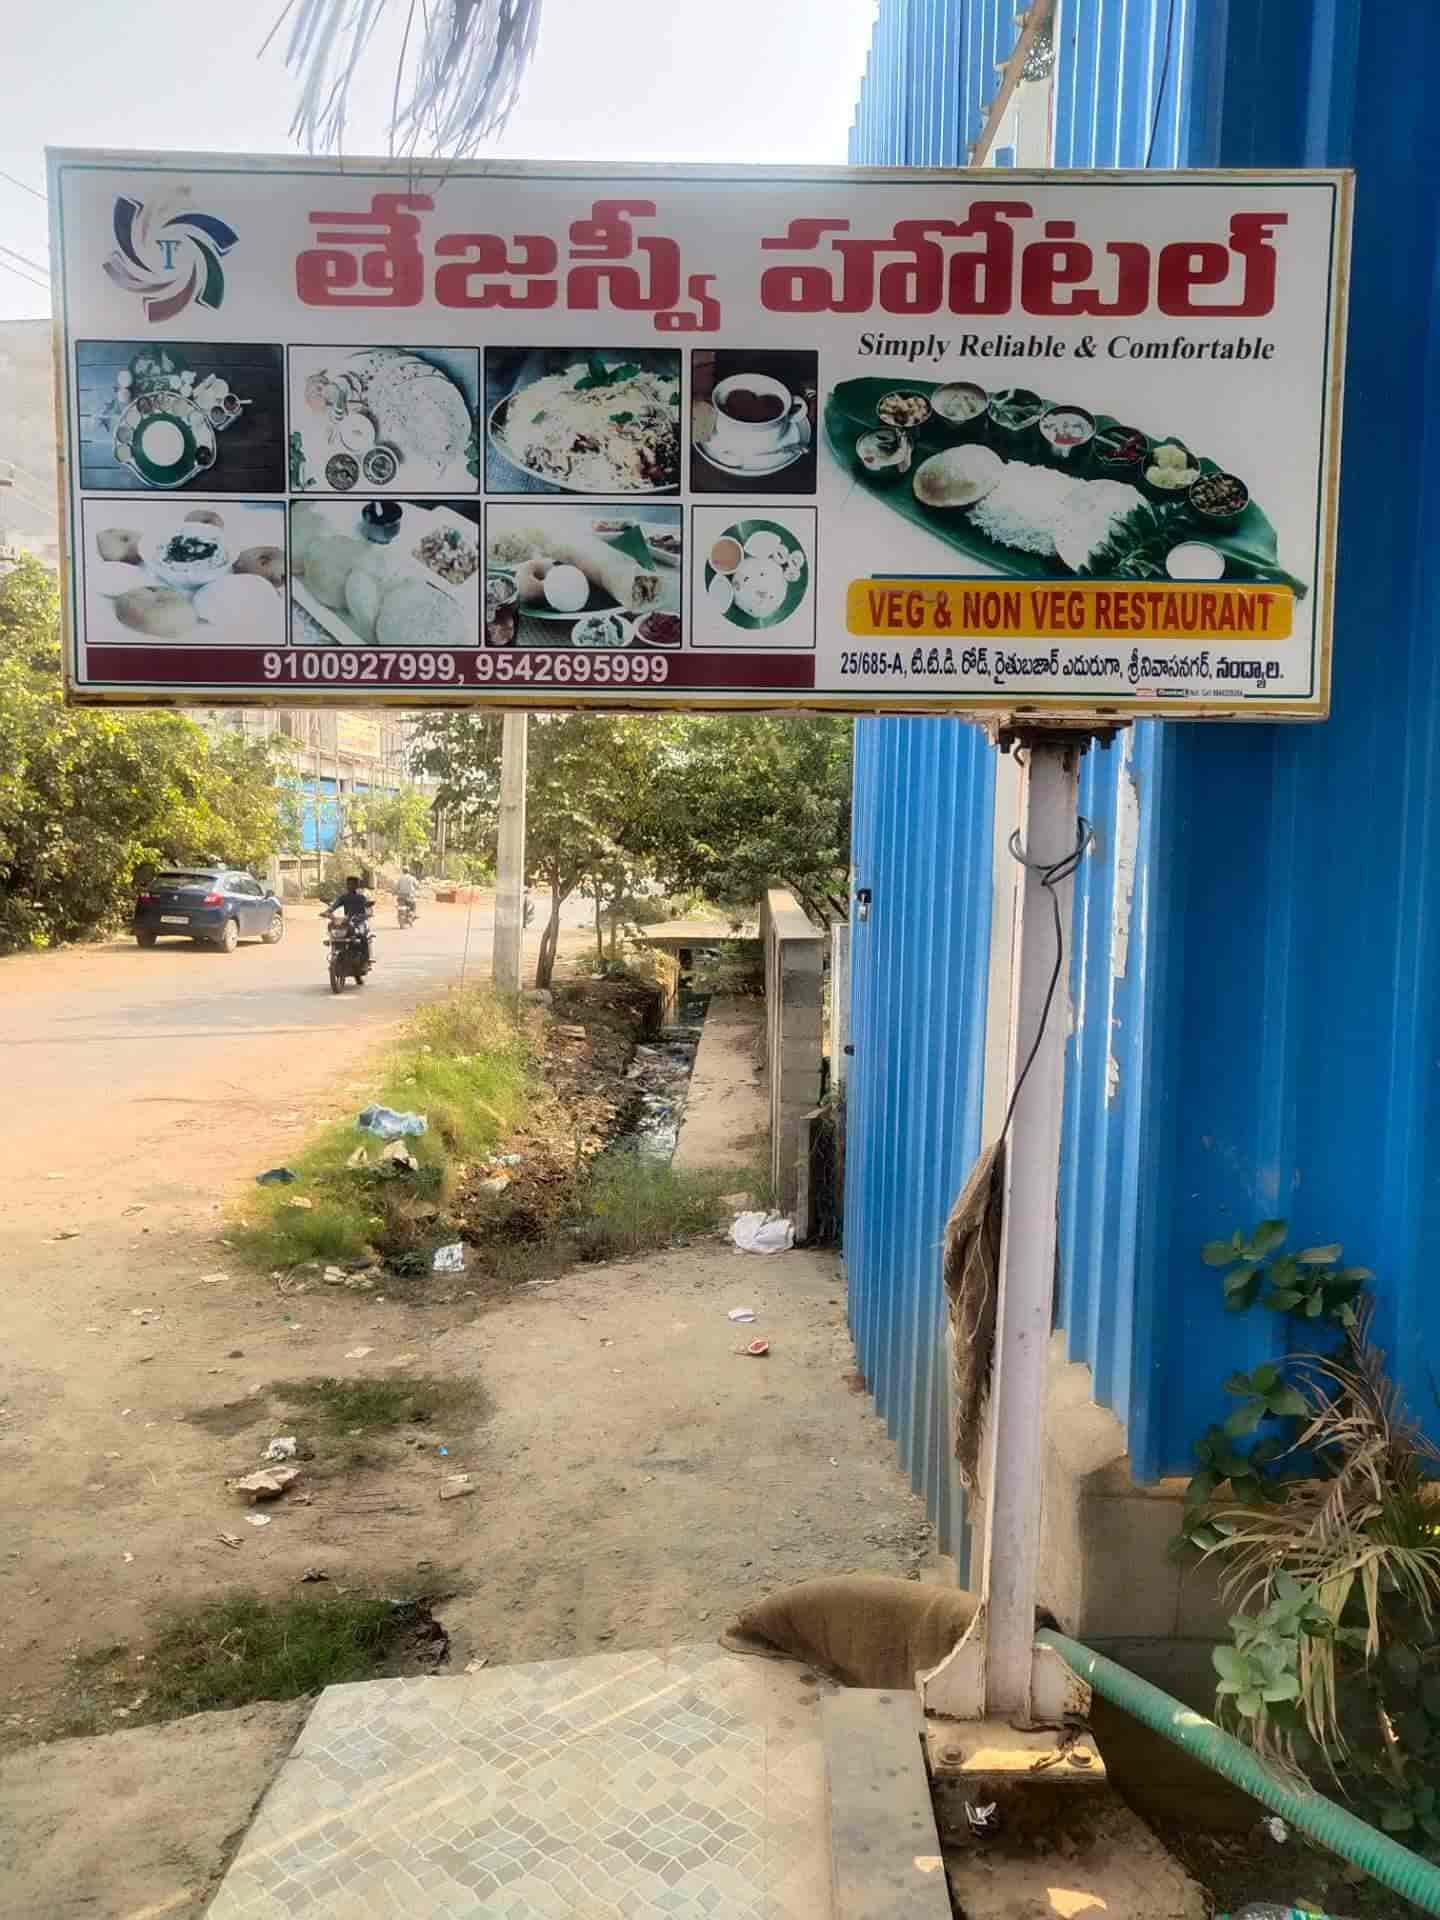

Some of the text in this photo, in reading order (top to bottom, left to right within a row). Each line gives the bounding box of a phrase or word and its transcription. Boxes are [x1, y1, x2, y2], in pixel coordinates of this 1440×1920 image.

[760, 201, 1288, 317] హోటల్
[857, 333, 1275, 363] Simply Reliable & Comfortable
[867, 589, 1274, 632] VEG & NON VEG RESTAURANT
[263, 652, 669, 686] 9100927999, 9542695999
[840, 652, 908, 678] 25/685-A,
